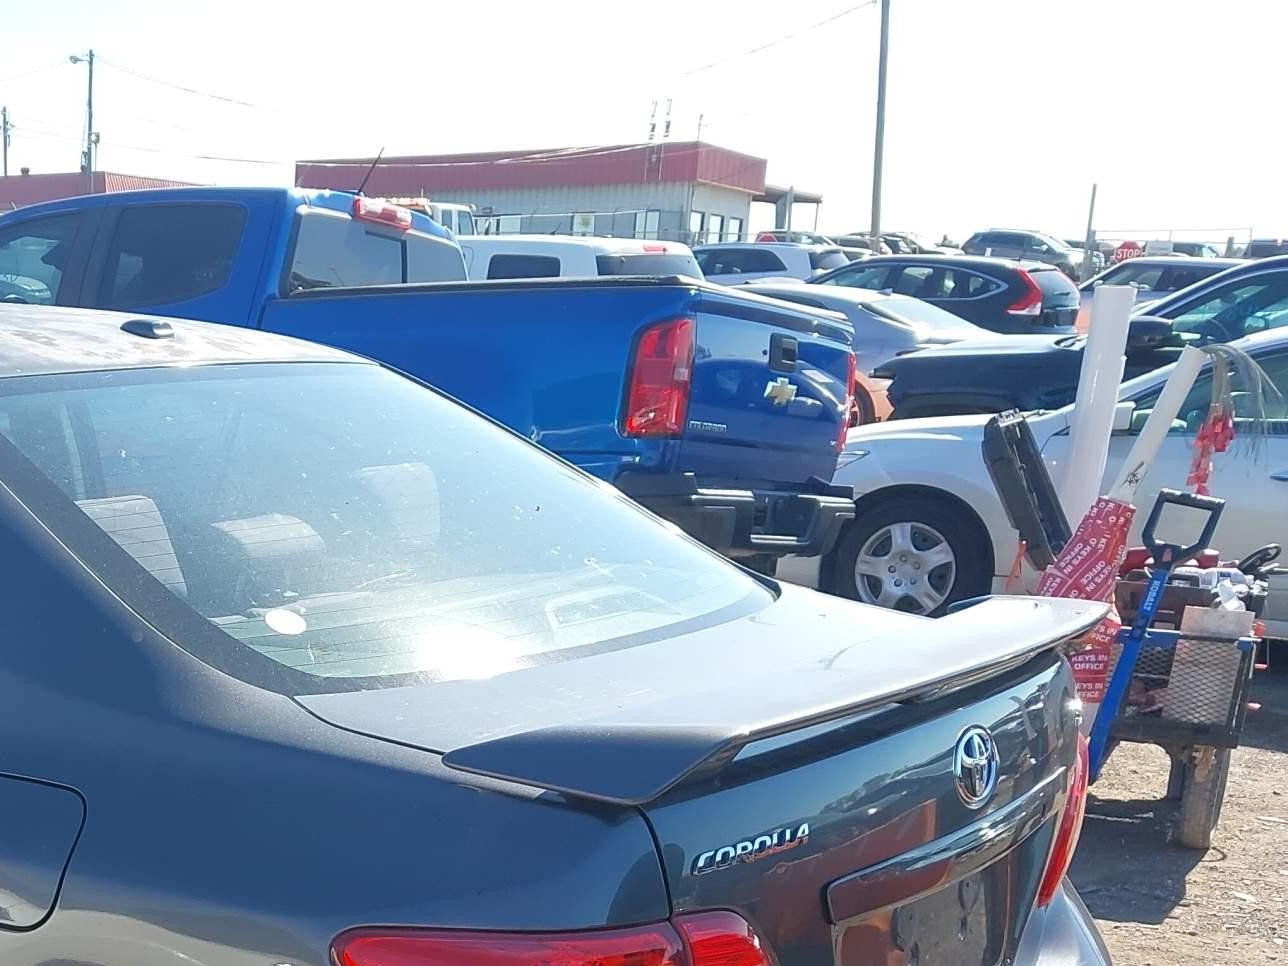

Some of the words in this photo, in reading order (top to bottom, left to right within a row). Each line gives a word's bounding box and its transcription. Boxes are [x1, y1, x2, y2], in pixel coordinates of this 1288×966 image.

[1116, 248, 1141, 259] STOP
[1058, 542, 1083, 568] OFFICE
[1072, 545, 1092, 566] KEYS
[1080, 560, 1106, 585] OFFICE
[1143, 580, 1161, 611] KOBALT
[1072, 654, 1096, 662] KEYS
[1073, 662, 1105, 671] OFFICE
[1076, 682, 1093, 690] EYS
[1077, 690, 1100, 698] FFICE
[692, 822, 810, 876] COROLLA
